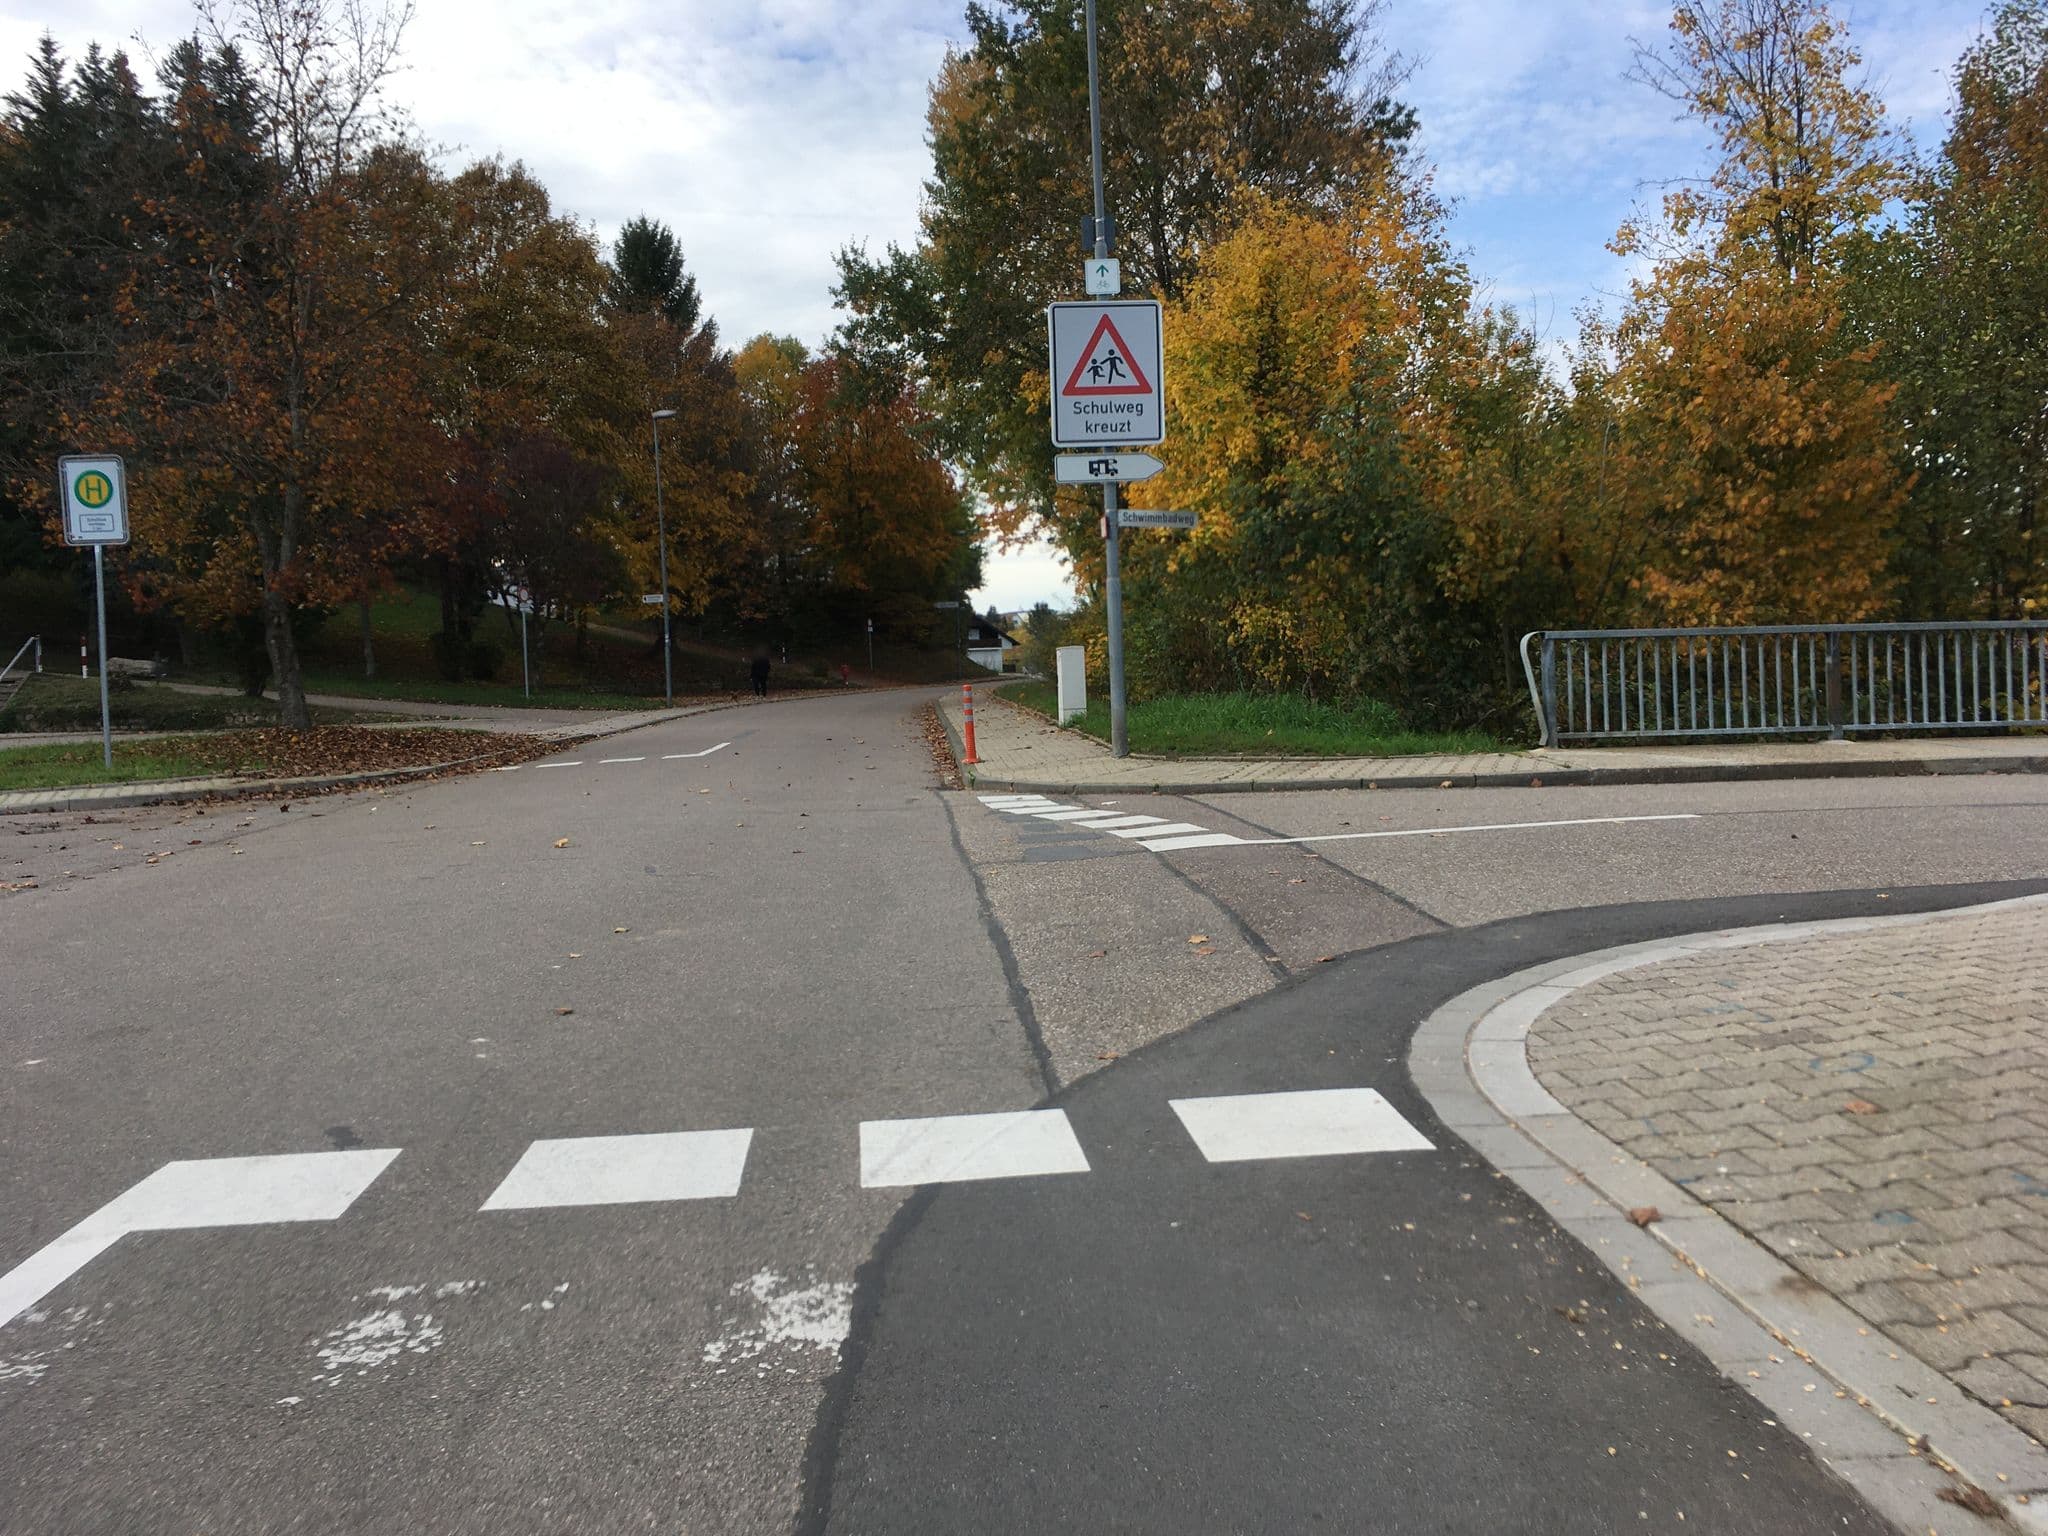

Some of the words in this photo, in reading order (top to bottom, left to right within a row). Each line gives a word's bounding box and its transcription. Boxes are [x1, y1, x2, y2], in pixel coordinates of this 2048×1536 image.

[1073, 400, 1144, 416] Schulweg
[1085, 420, 1132, 433] kreuzt
[85, 479, 103, 501] H
[1122, 511, 1195, 526] Schwimmbadweg
